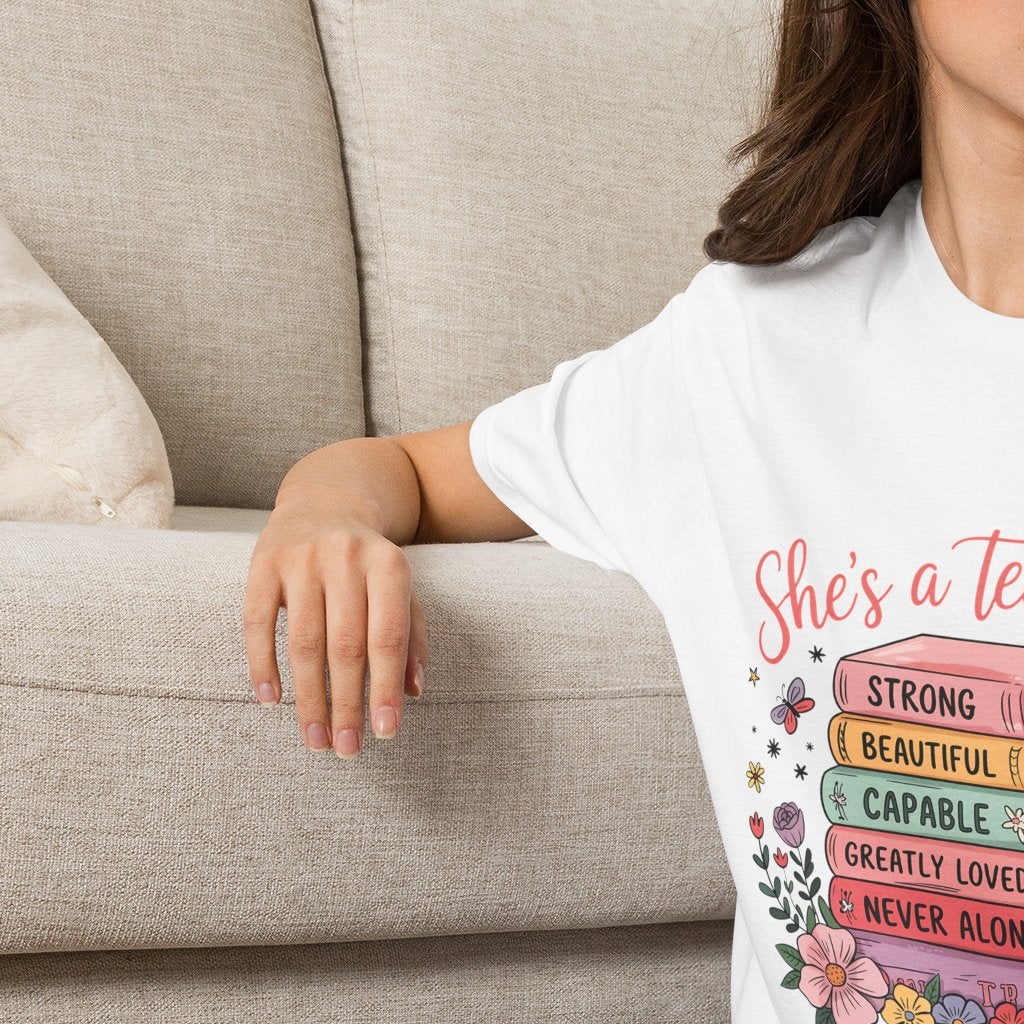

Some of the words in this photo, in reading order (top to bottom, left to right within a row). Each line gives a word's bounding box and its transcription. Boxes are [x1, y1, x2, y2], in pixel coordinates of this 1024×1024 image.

[755, 537, 893, 665] She's
[910, 562, 952, 607] a
[867, 675, 976, 721] STRONG
[861, 731, 997, 778] BEAUTIFUL
[863, 786, 991, 836] CAPABLE
[844, 841, 944, 880] GREATLY
[863, 895, 948, 936] NEVER
